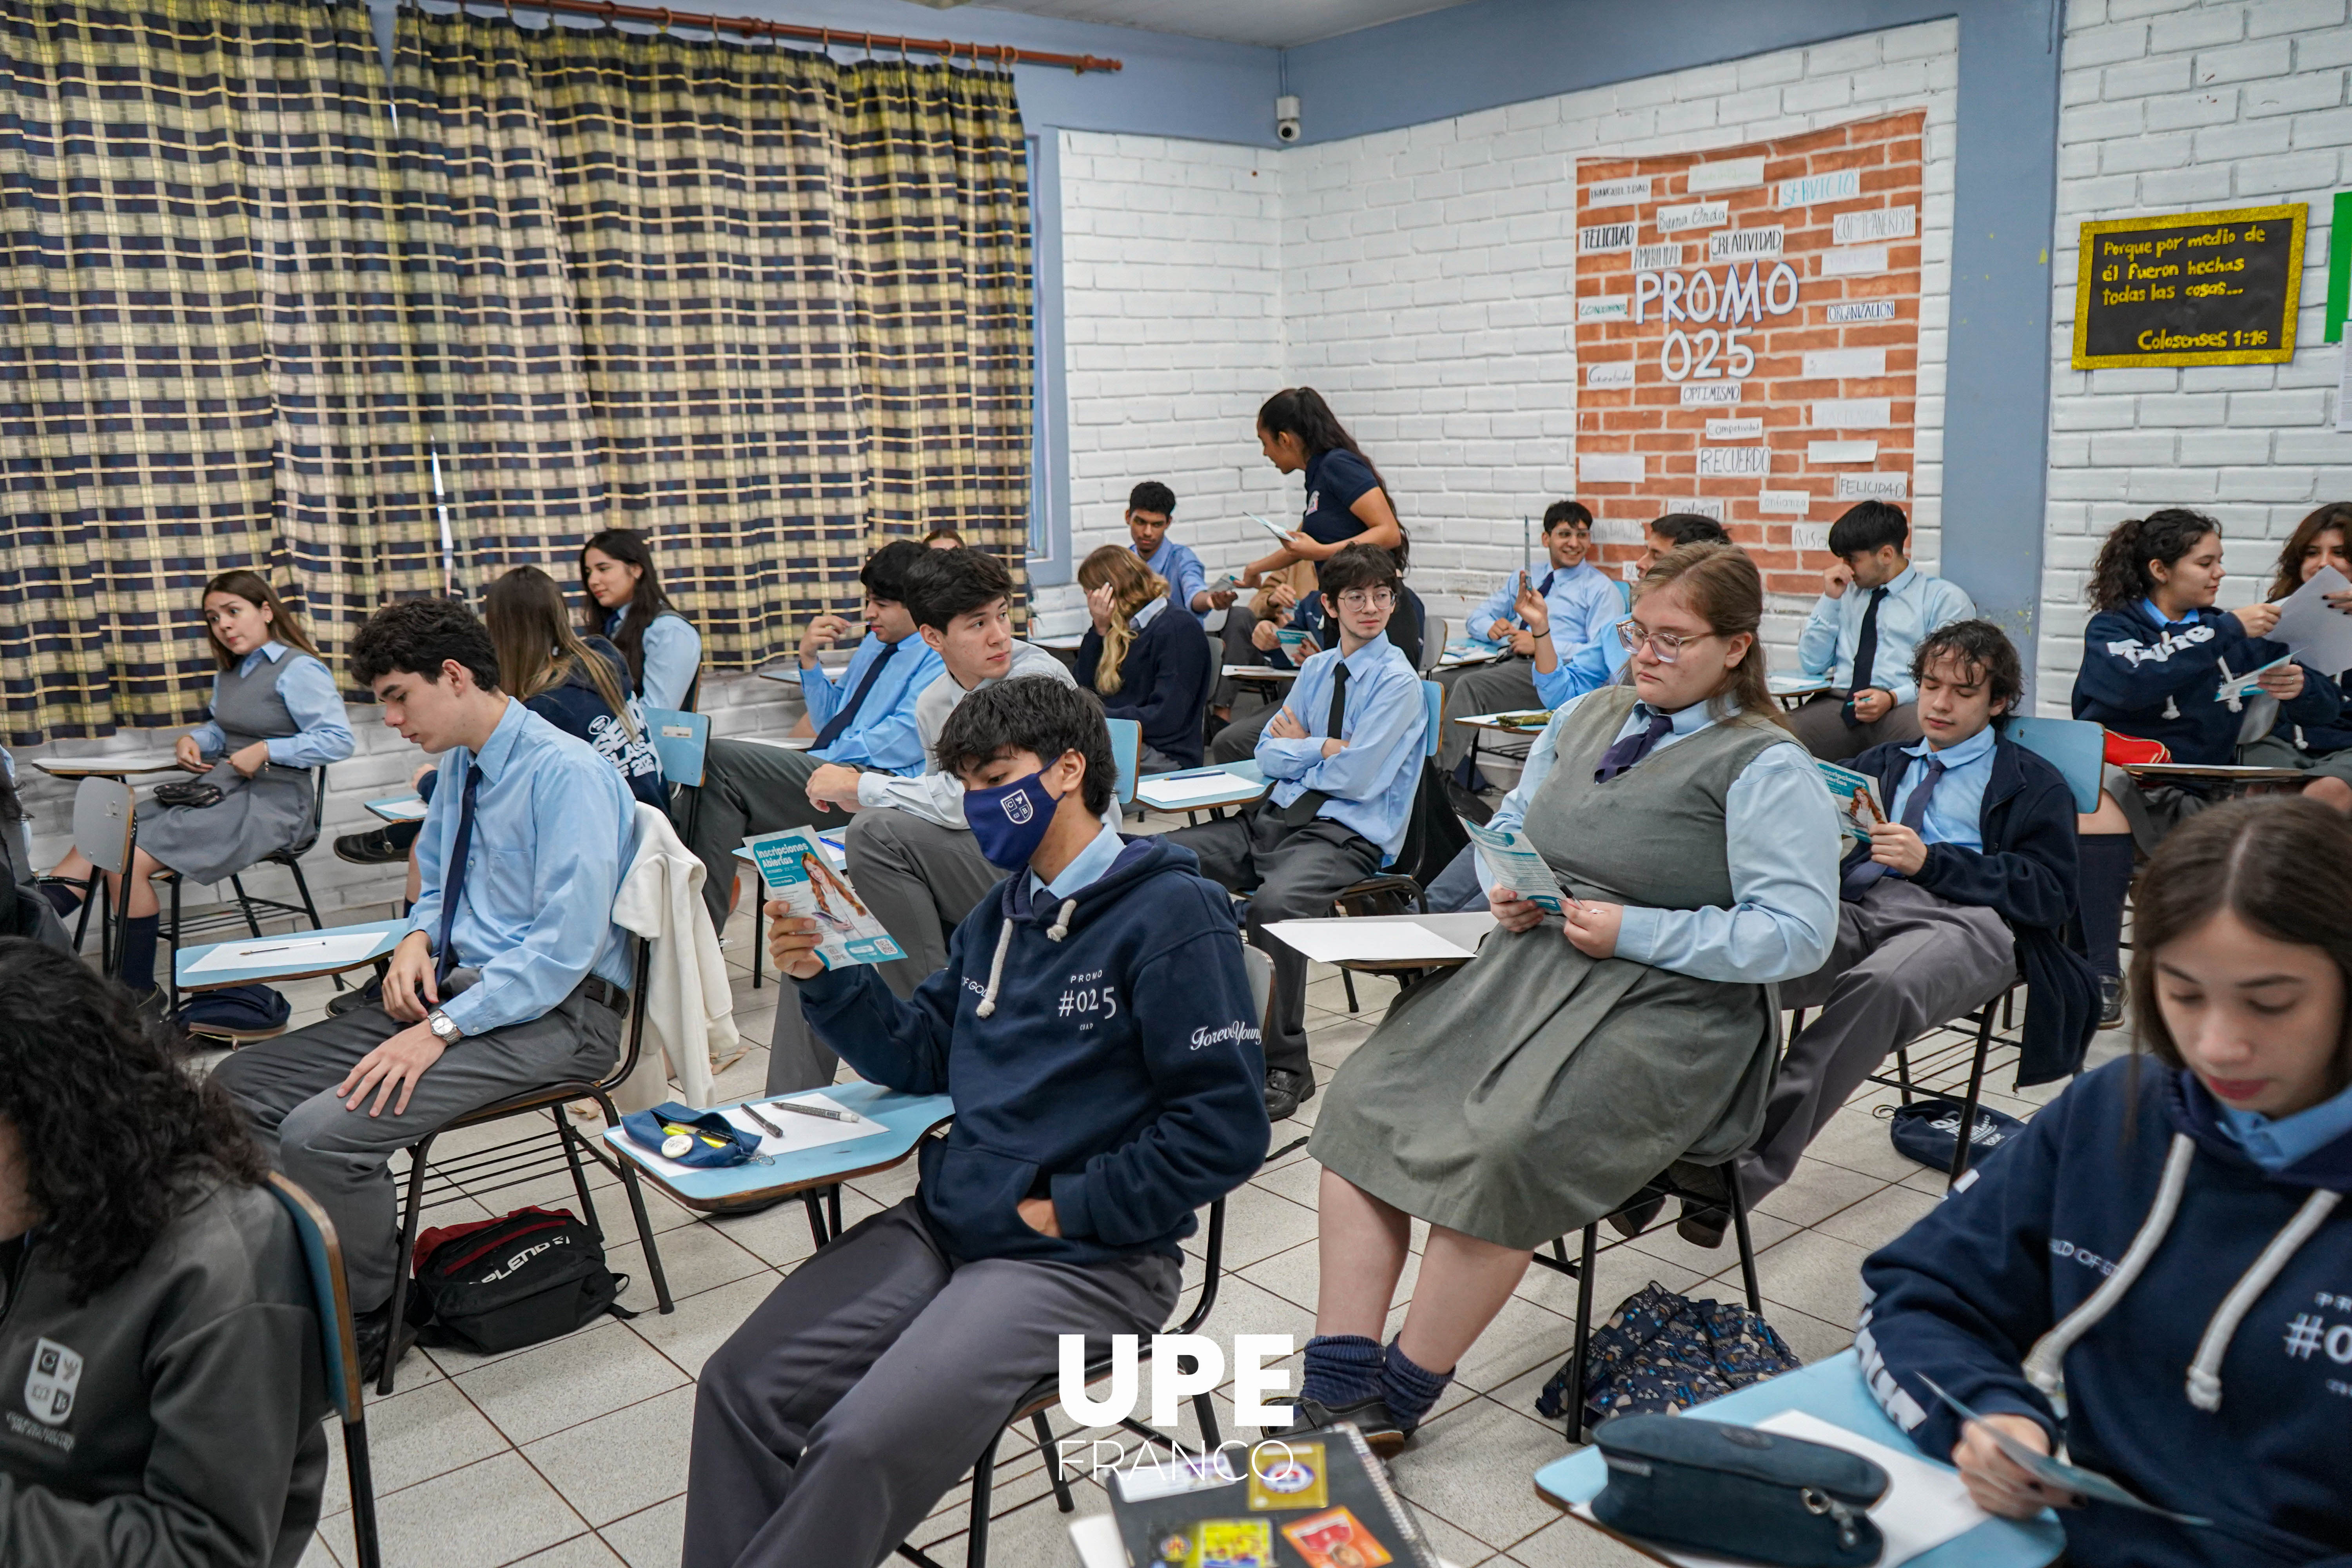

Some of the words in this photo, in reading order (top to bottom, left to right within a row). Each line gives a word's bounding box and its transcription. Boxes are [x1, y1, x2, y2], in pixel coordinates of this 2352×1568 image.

[1784, 172, 1855, 206] SERVICIO
[1583, 225, 1635, 249] FELICIDAD
[1711, 230, 1781, 256] CREATIVIDAD
[2104, 241, 2152, 262] Porque
[2156, 236, 2184, 258] por
[2187, 228, 2236, 248] medio
[2244, 225, 2266, 242] de
[2102, 264, 2119, 282] él
[2127, 262, 2179, 280] fueron
[2187, 256, 2245, 275] hechas
[1635, 259, 1799, 325] PROMO
[2102, 285, 2146, 306] todas
[2151, 283, 2176, 301] las
[2138, 328, 2228, 351] Colosenses
[2233, 330, 2269, 347] 1:16
[1661, 326, 1755, 382] 025
[1684, 385, 1740, 401] OPTIMISMO
[1701, 447, 1770, 473] RECUERDO
[1840, 478, 1906, 499] FELICIDAD
[756, 843, 809, 859] Inscripciones
[762, 856, 794, 868] Abiertas
[1071, 969, 1102, 984] PROMO
[1059, 986, 1116, 1020] #025
